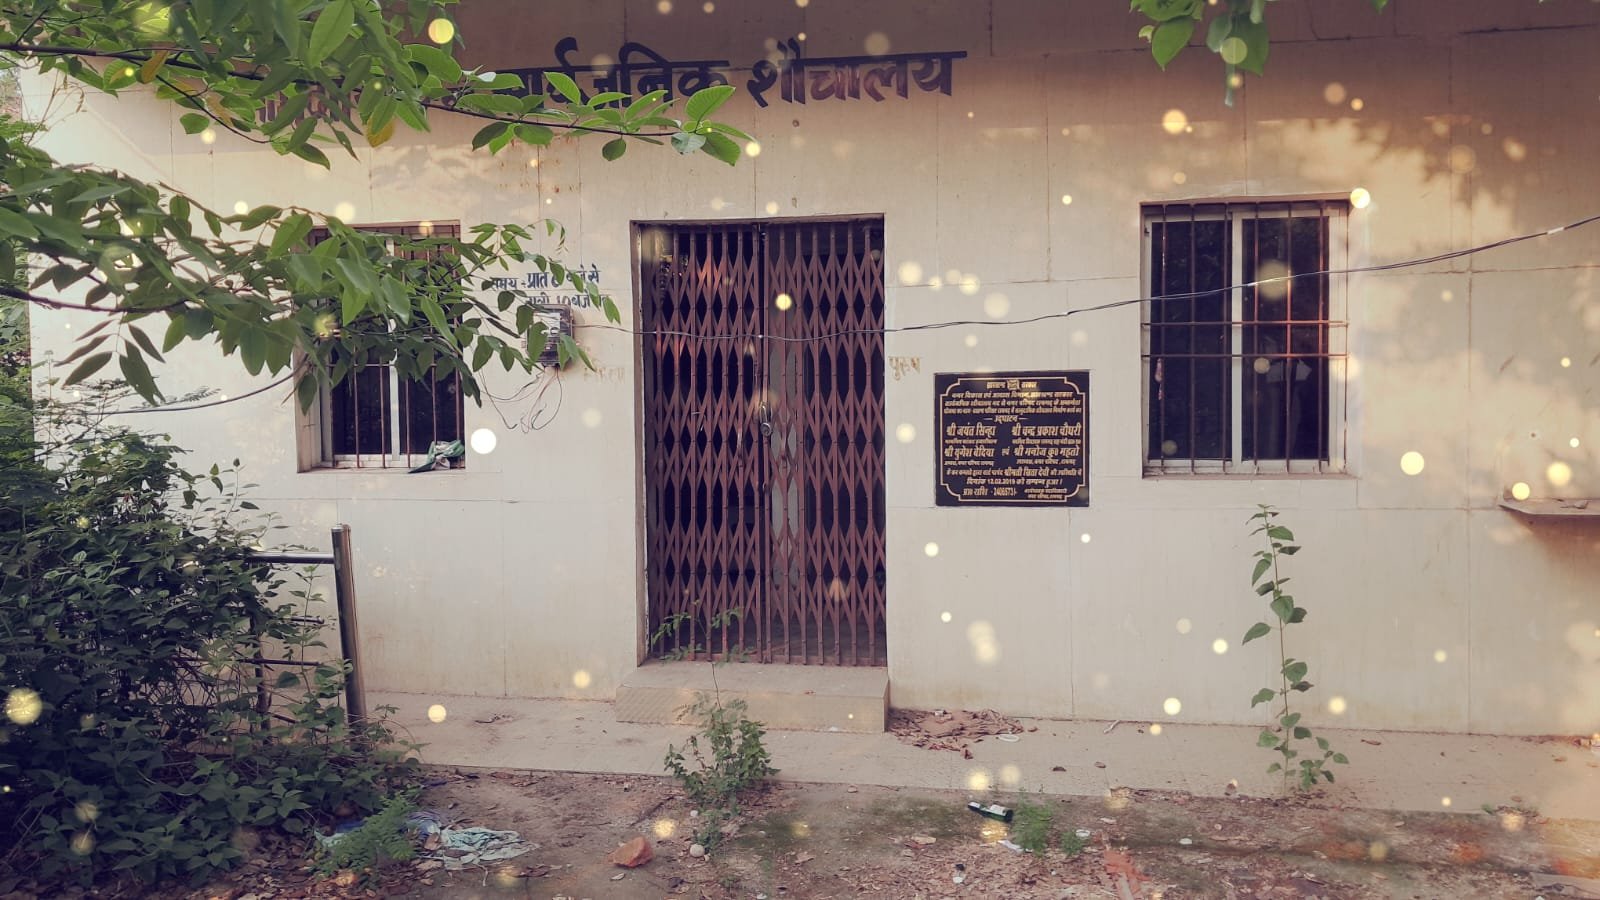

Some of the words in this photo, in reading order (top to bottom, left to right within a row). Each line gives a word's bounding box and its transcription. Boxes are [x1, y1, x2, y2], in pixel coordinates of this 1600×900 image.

[746, 38, 968, 108] शौचालय
[588, 263, 602, 283] से
[946, 422, 957, 436] श्री
[957, 422, 975, 436] जयंत
[975, 422, 996, 438] सिन्हा
[1012, 422, 1021, 436] श्री
[1022, 426, 1036, 436] चन्द्र
[1037, 426, 1058, 436] प्रकाश
[1059, 422, 1081, 436] चौधरी
[944, 445, 953, 457] श्री
[1014, 444, 1024, 456] श्री
[1025, 445, 1047, 456] मनोज
[1059, 445, 1080, 458] महतो
[1004, 466, 1023, 476] श्रीमती
[1038, 466, 1050, 476] देवी
